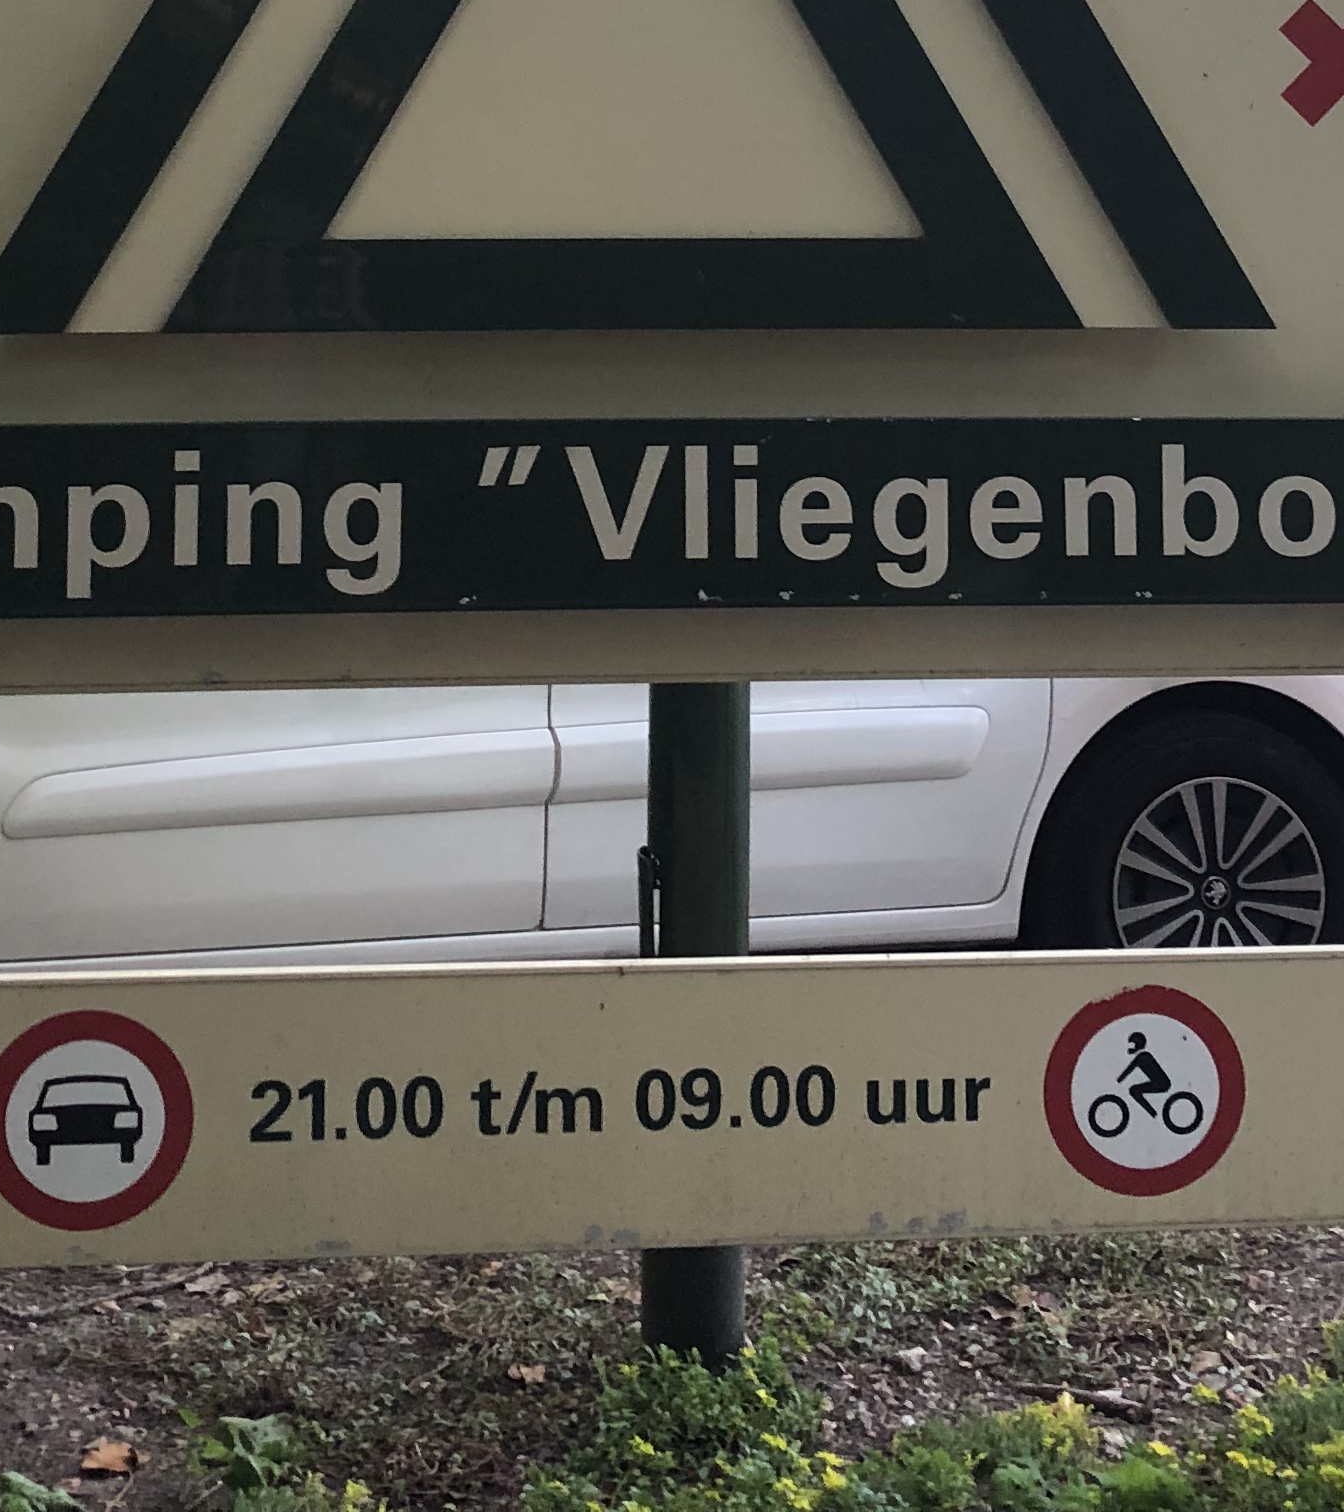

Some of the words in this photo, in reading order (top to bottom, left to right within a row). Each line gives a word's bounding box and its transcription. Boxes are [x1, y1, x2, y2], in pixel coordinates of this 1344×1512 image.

[248, 1074, 446, 1143] 21.00
[469, 1070, 605, 1138] t/m
[634, 1063, 838, 1133] 09.00
[864, 1076, 992, 1126] uur
